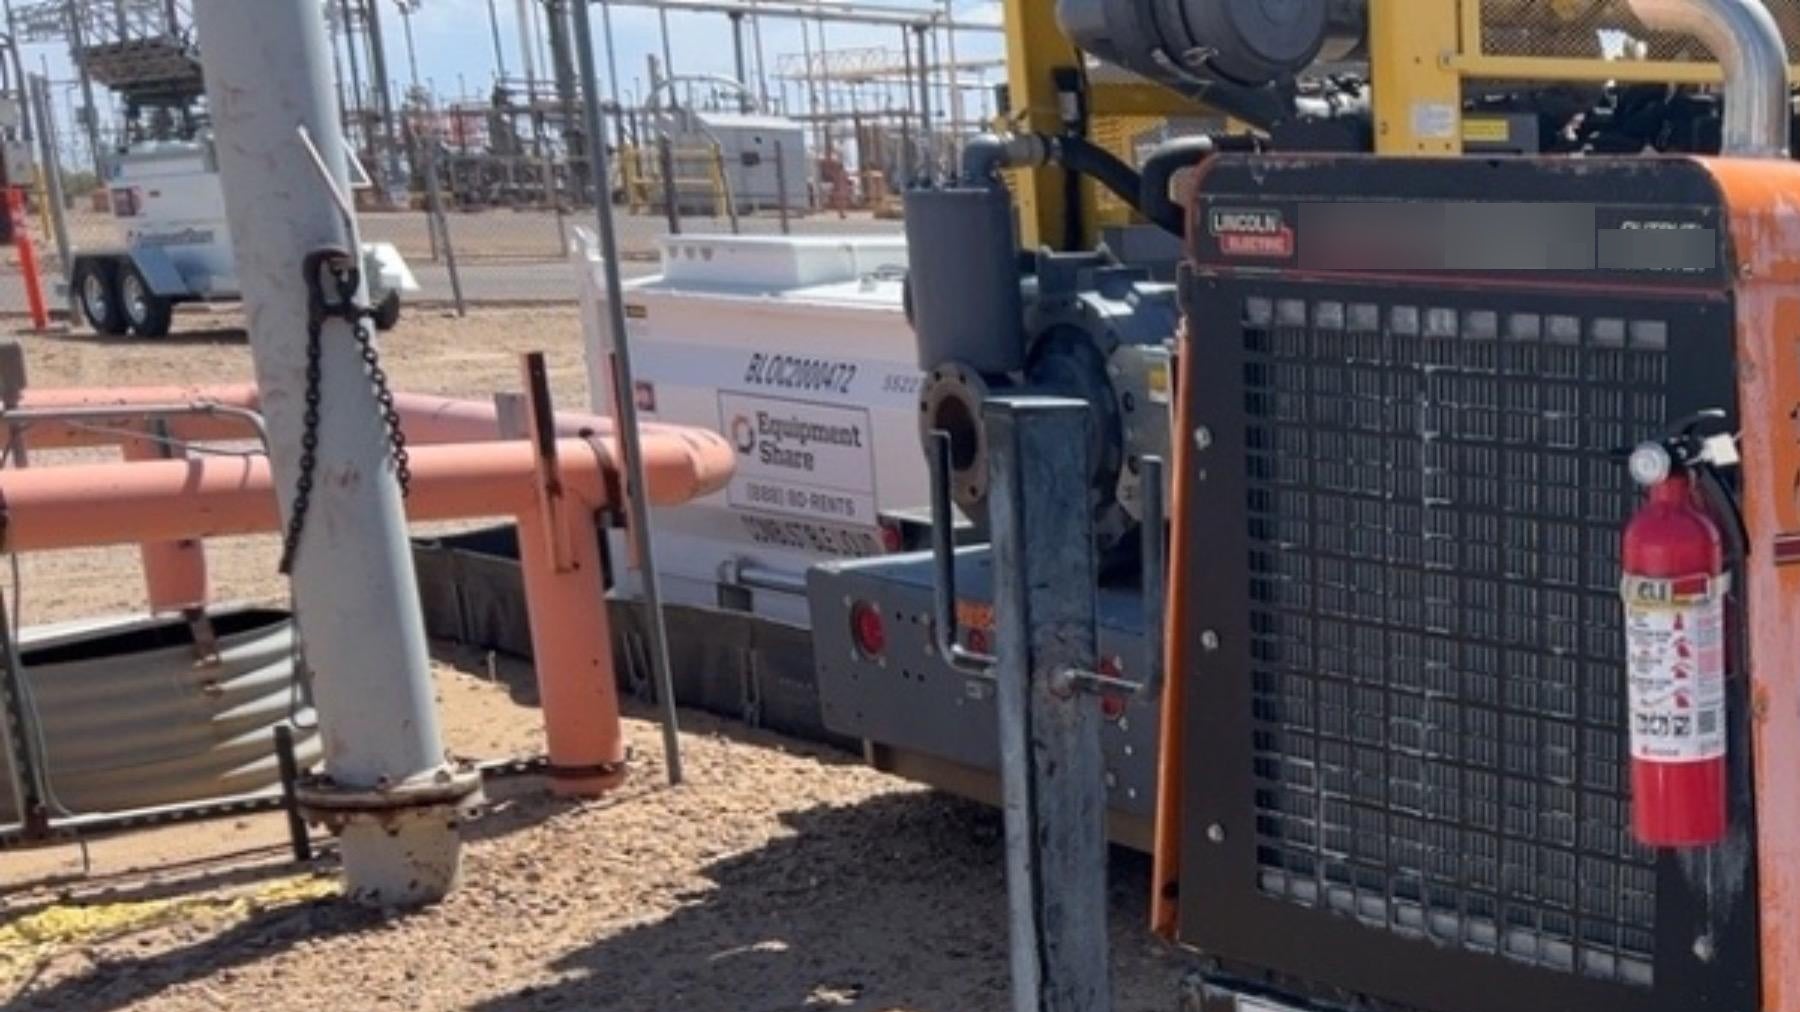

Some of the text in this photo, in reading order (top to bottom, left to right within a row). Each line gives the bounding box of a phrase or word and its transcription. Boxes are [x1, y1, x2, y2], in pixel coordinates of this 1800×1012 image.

[1214, 213, 1276, 233] LINCOLN
[756, 410, 862, 448] Equipment
[759, 440, 814, 471] Share
